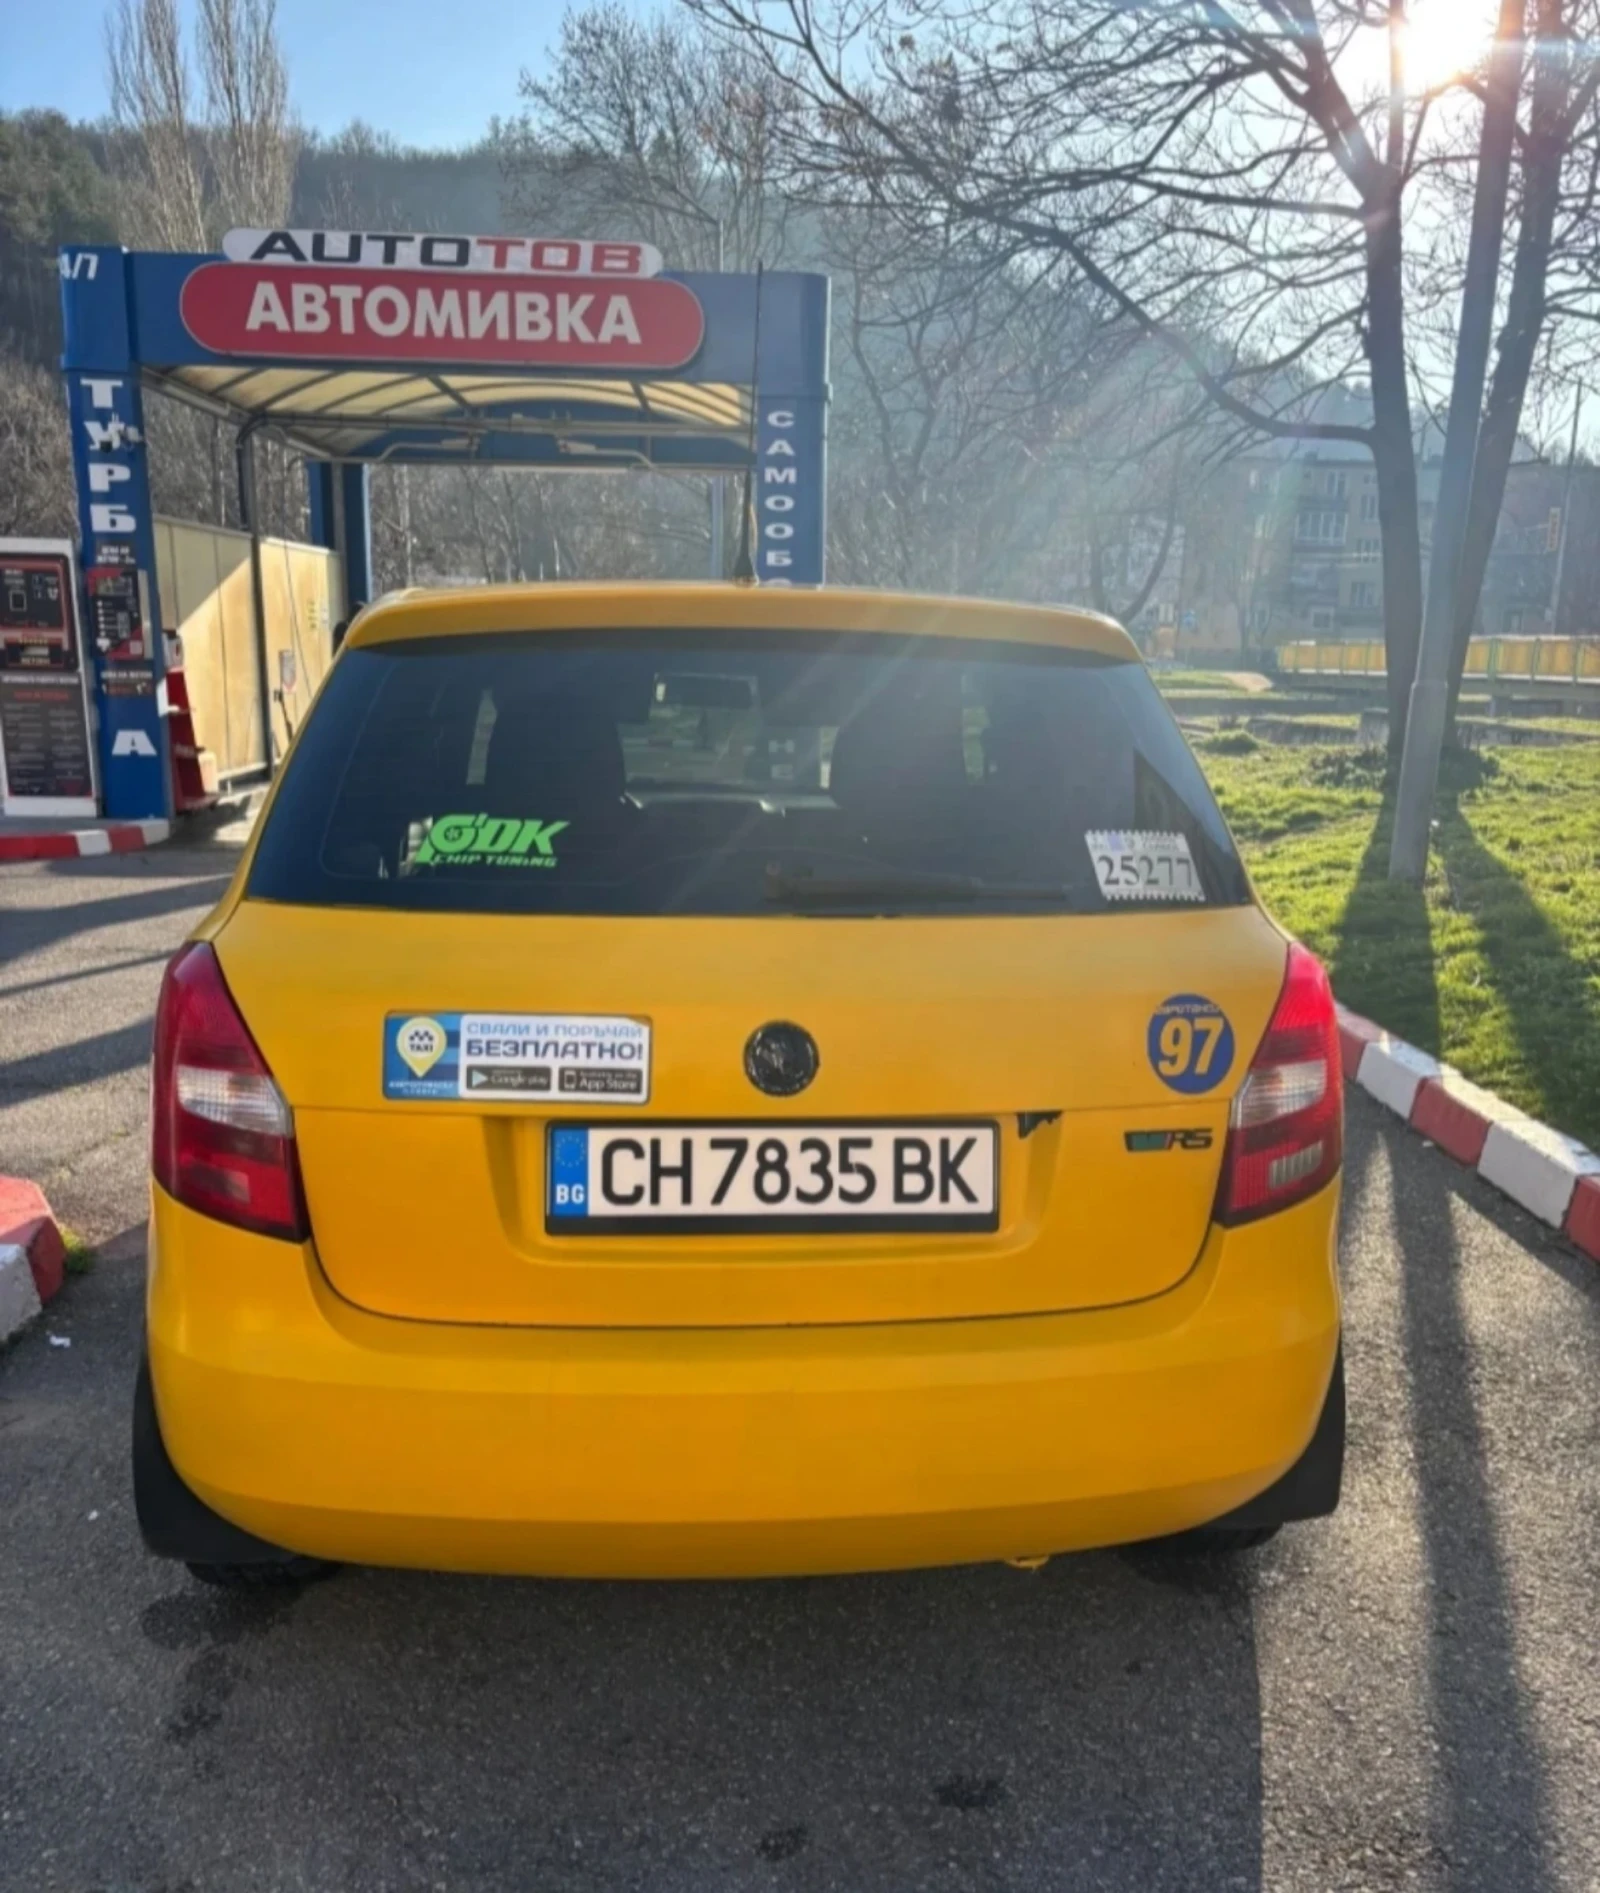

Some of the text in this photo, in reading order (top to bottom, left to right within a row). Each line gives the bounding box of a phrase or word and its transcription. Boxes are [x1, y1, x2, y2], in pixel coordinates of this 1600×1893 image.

[245, 281, 642, 345] АВТОМИВКА
[1097, 854, 1193, 887] 25277
[466, 1022, 530, 1037] СВАЛИ
[536, 1023, 549, 1037] И
[409, 1043, 435, 1053] TAXI
[466, 1039, 644, 1061] БЕЗПЛАТНО!
[1158, 1016, 1225, 1077] 97
[579, 1077, 638, 1092] App Store
[555, 1137, 979, 1206] BG CH 7835 BK
